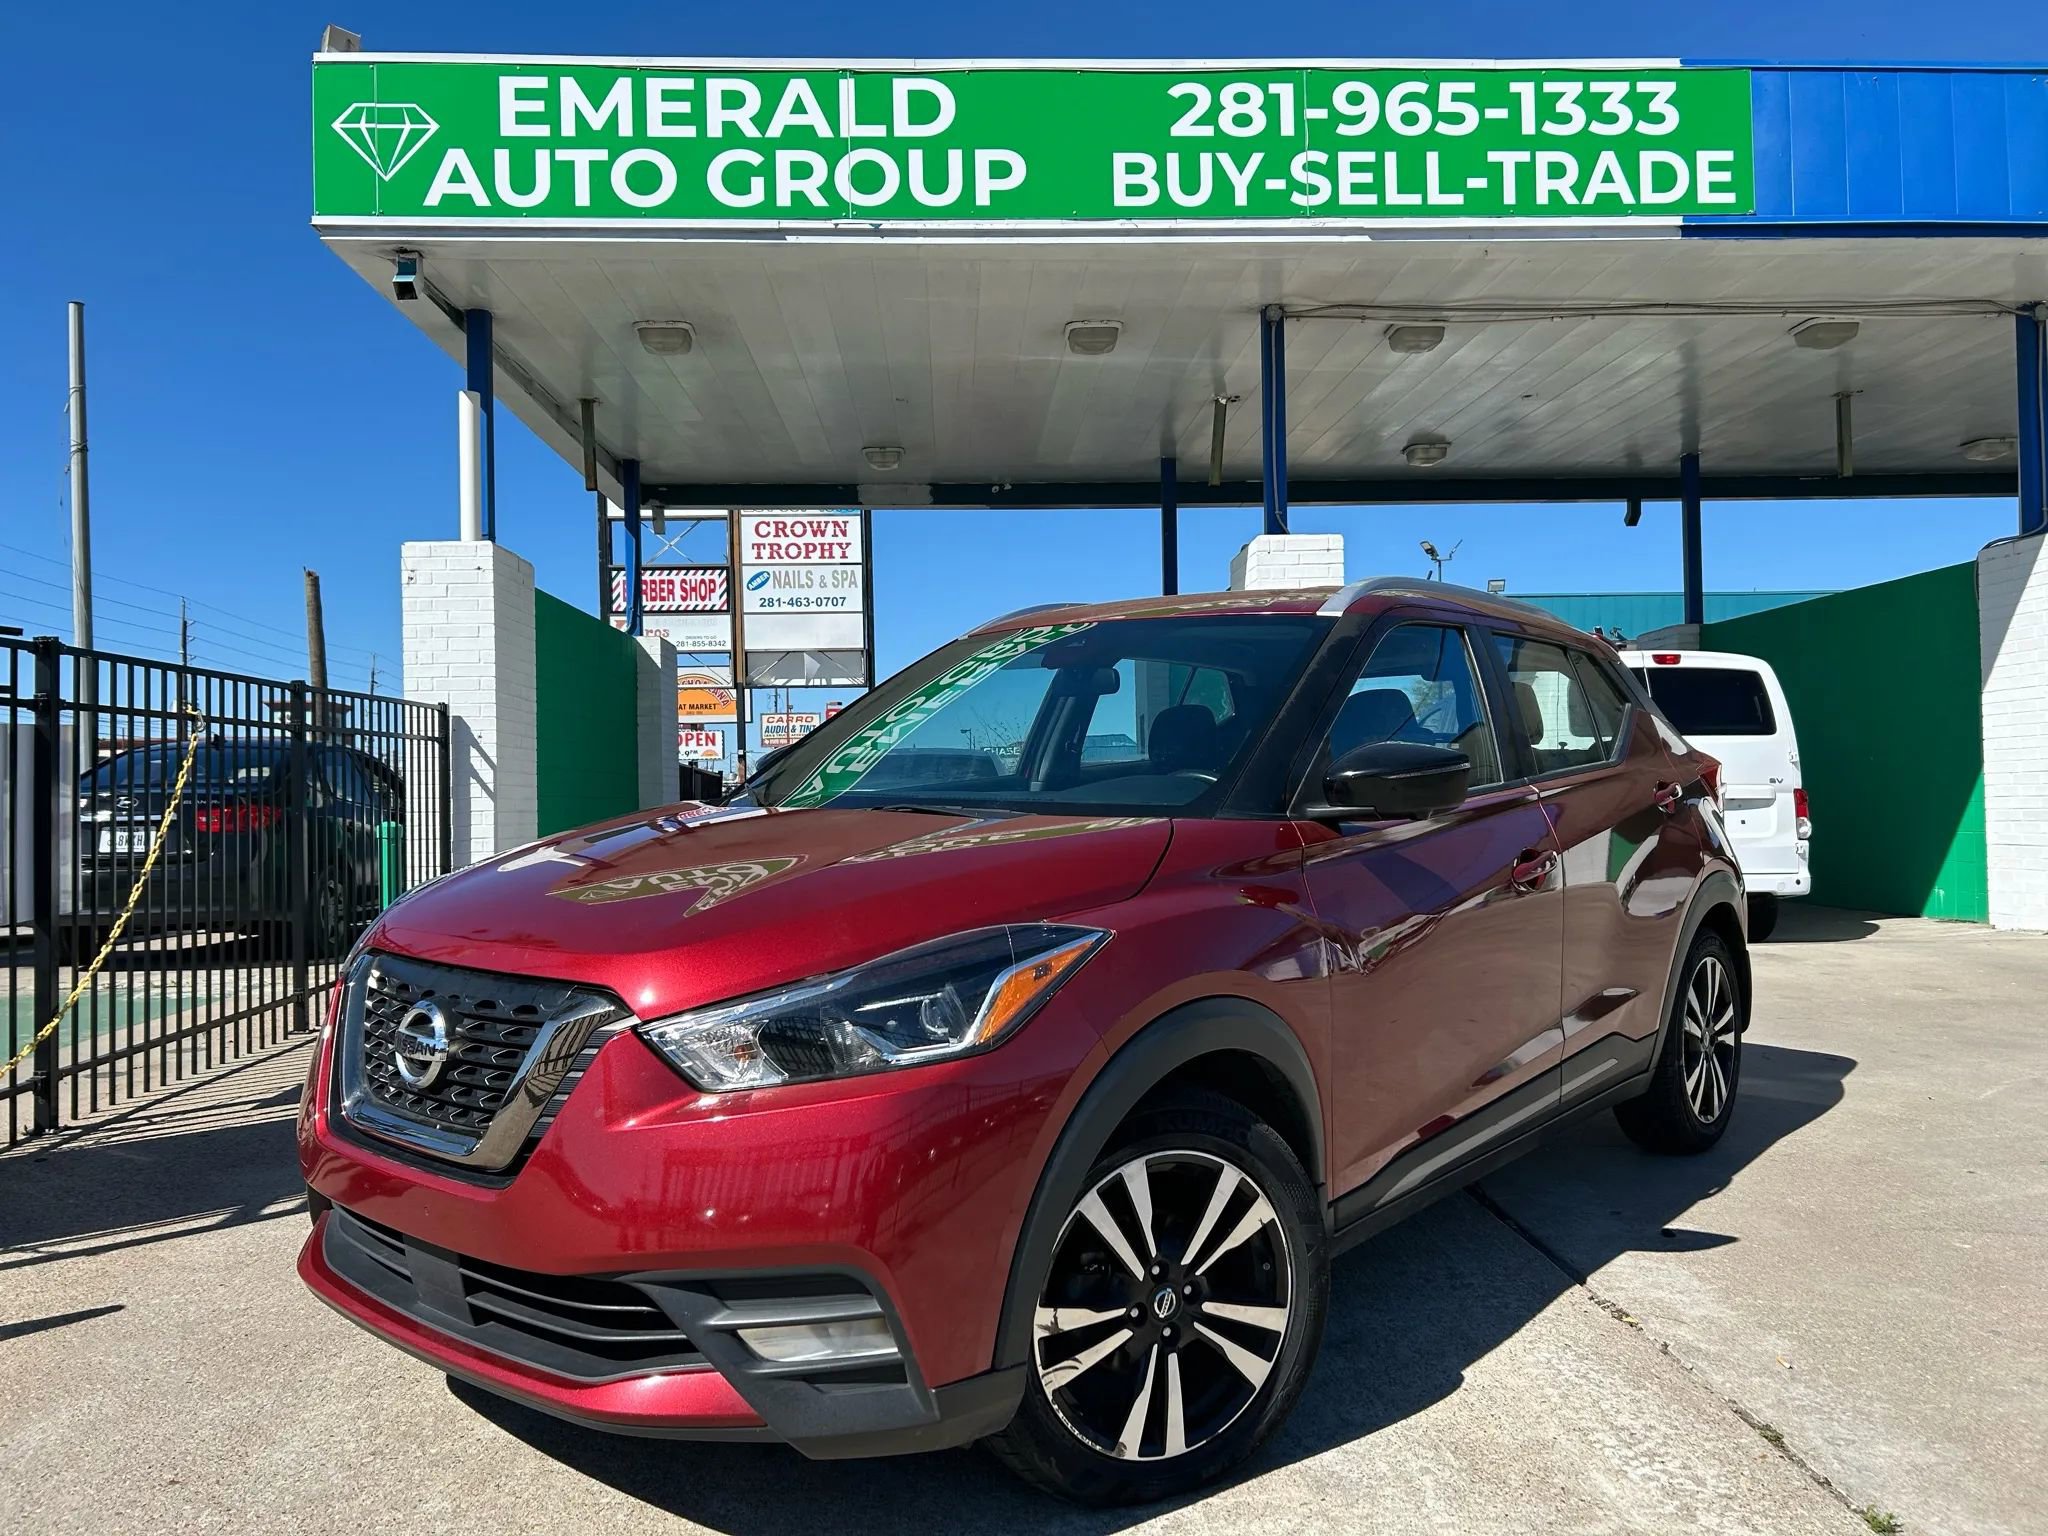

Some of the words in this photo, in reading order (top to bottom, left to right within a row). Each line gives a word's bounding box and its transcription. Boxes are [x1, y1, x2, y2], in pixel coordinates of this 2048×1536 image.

[498, 76, 956, 138] EMERALD
[1167, 81, 1680, 137] 281-965-1333
[422, 148, 678, 208] AUTO
[706, 148, 1027, 208] GROUP
[1112, 150, 1737, 207] BUY-SELL-TRADE
[754, 520, 849, 538] CROWN
[751, 542, 852, 560] TROPHY
[623, 579, 675, 602] RBER
[680, 578, 716, 602] SHOP
[772, 570, 814, 589] NAILS
[818, 574, 827, 588] &
[831, 569, 858, 588] SPA
[759, 597, 847, 607] 281-463-0707
